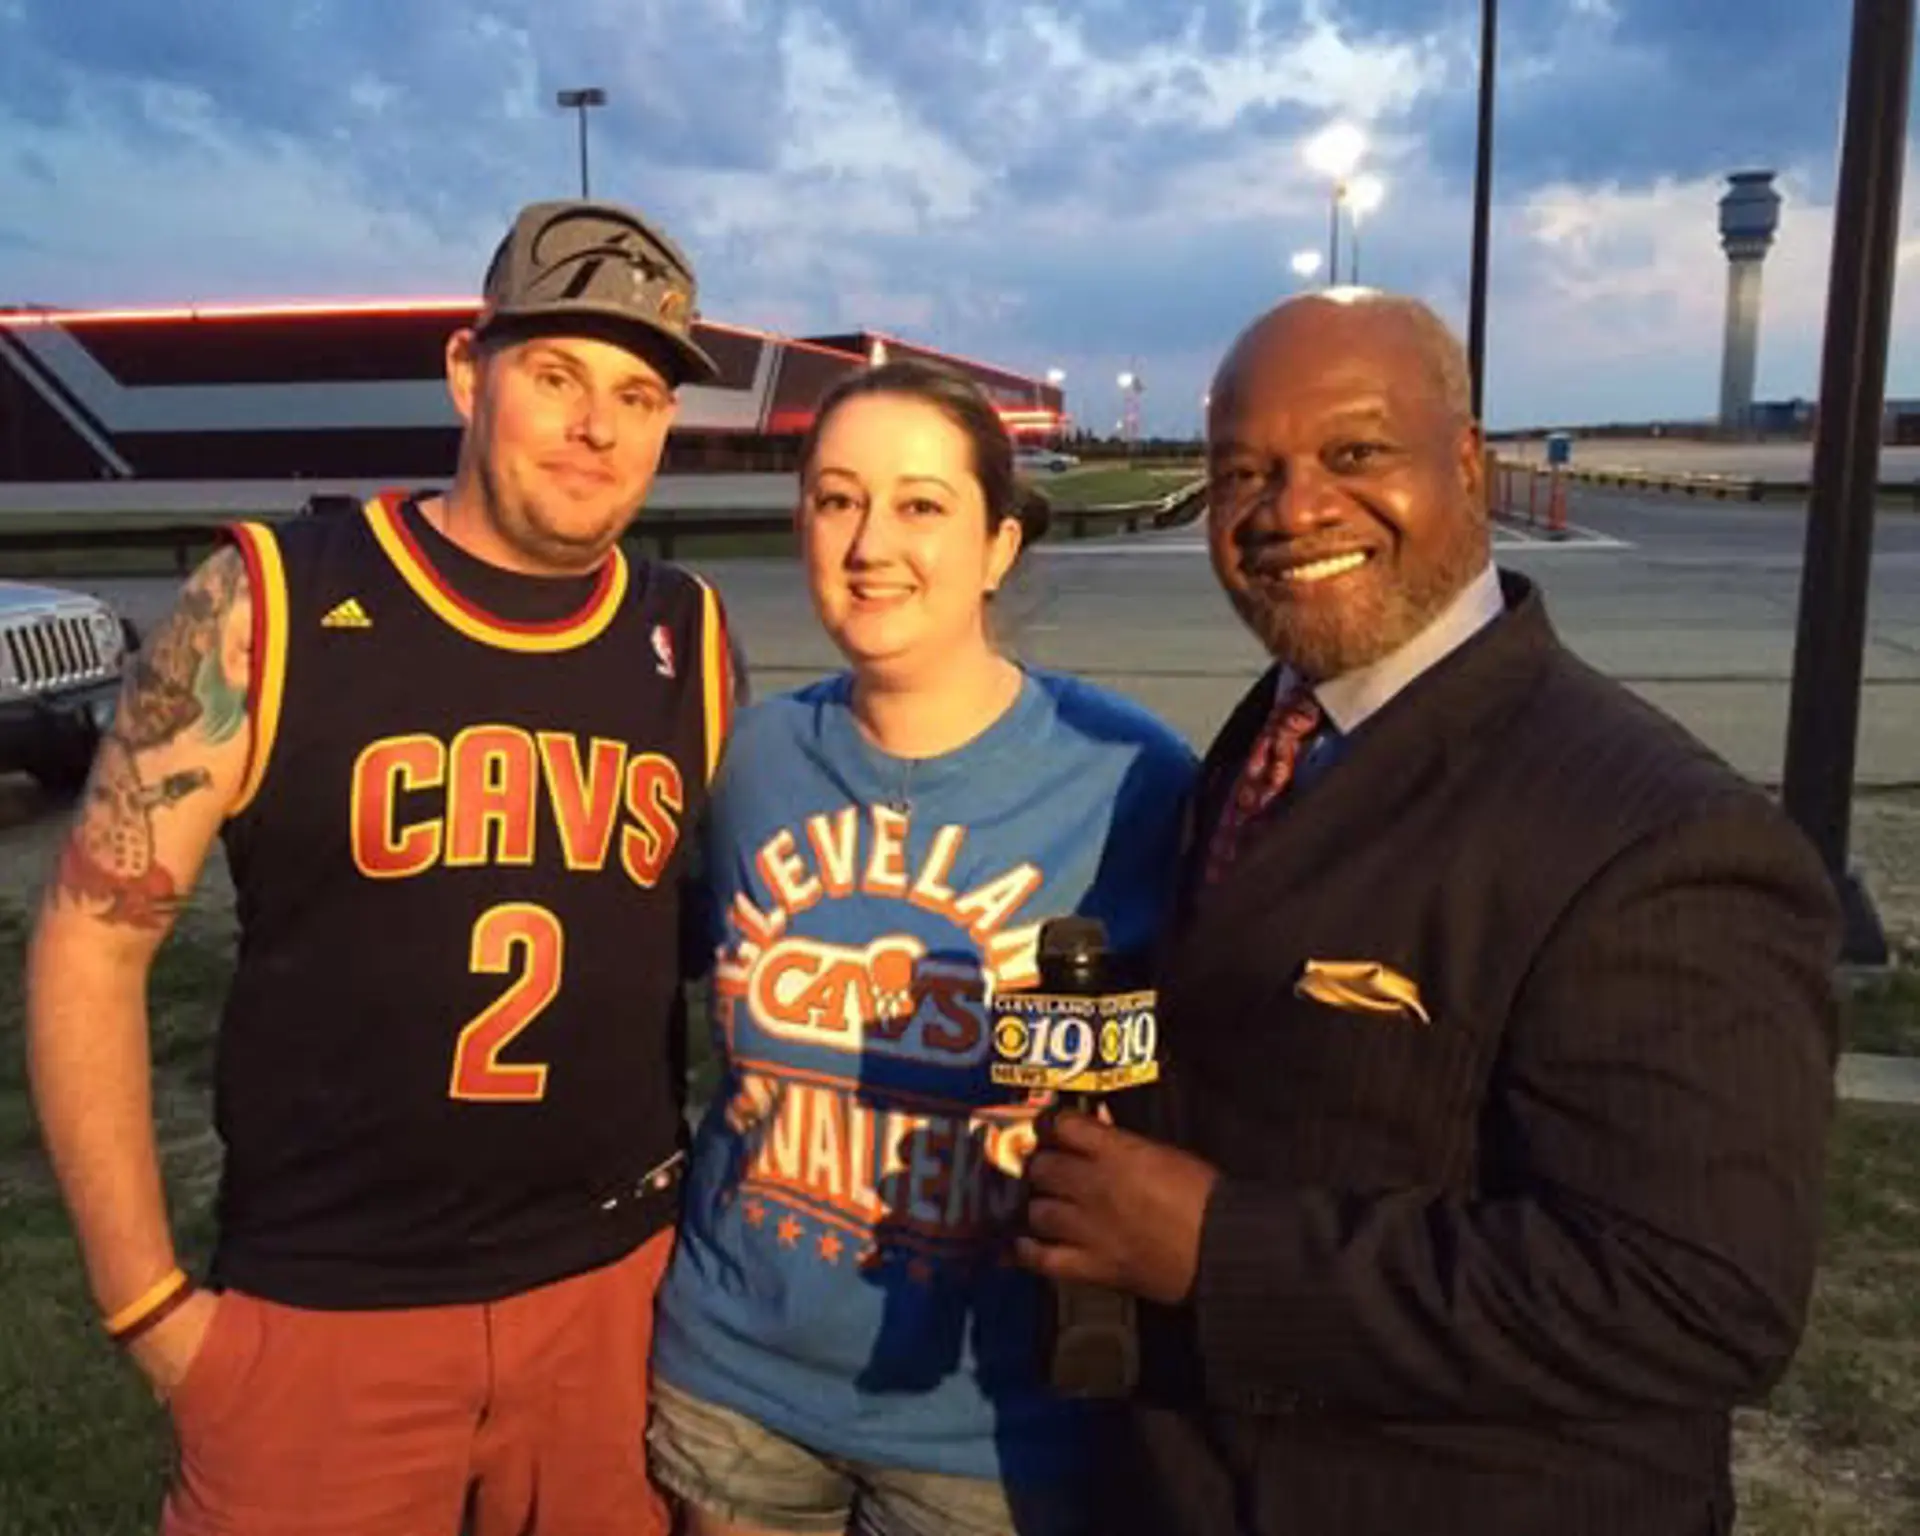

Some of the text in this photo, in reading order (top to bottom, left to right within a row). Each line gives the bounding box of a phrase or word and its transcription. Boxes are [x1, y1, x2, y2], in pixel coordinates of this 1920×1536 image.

[350, 724, 683, 888] CAVS
[715, 801, 1042, 1008] CLEVELAN
[449, 903, 564, 1102] 2
[1028, 1016, 1095, 1083] 19
[1119, 1011, 1156, 1070] 19
